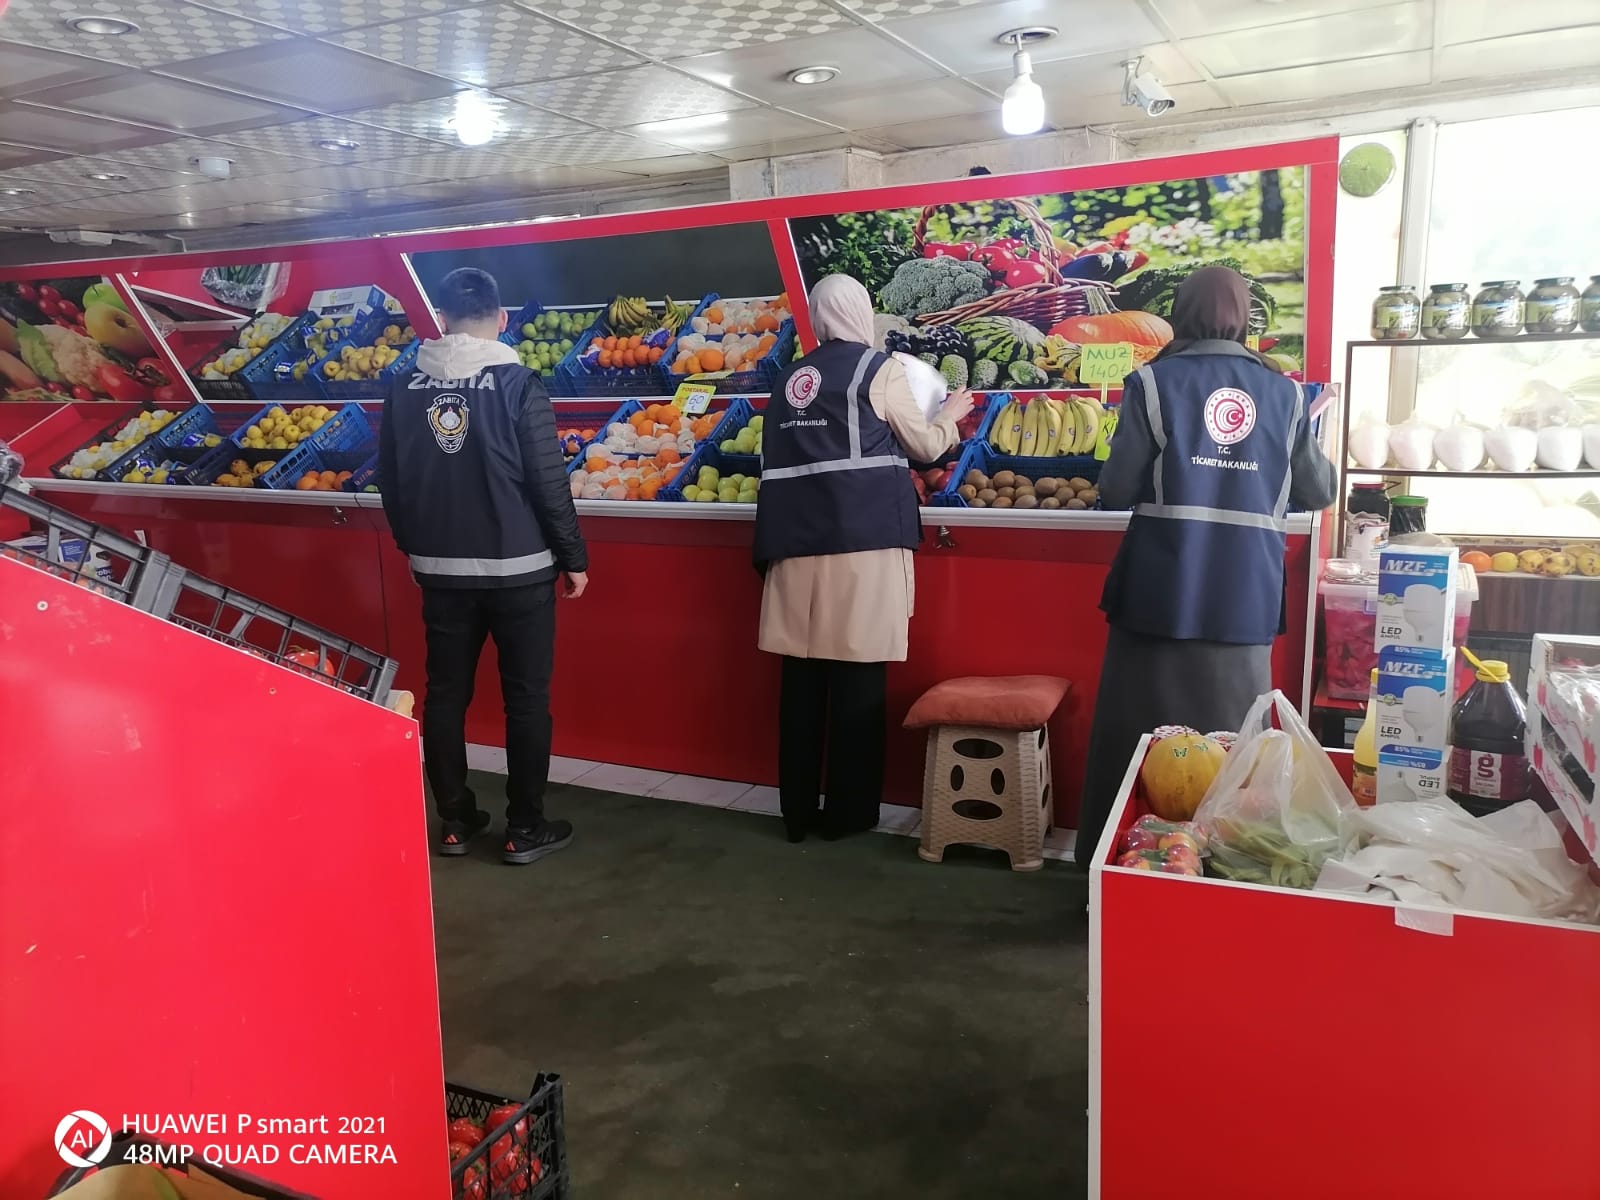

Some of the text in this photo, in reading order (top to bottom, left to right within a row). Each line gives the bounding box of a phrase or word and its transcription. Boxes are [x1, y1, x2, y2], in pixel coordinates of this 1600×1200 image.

[1217, 445, 1231, 455] T.C.
[1191, 456, 1259, 471] TİCARET BAKANLIĞI
[1385, 559, 1428, 572] MZF
[1380, 626, 1402, 635] LED
[1384, 660, 1425, 674] MZF
[1380, 725, 1402, 735] LED
[1418, 779, 1440, 789] LED
